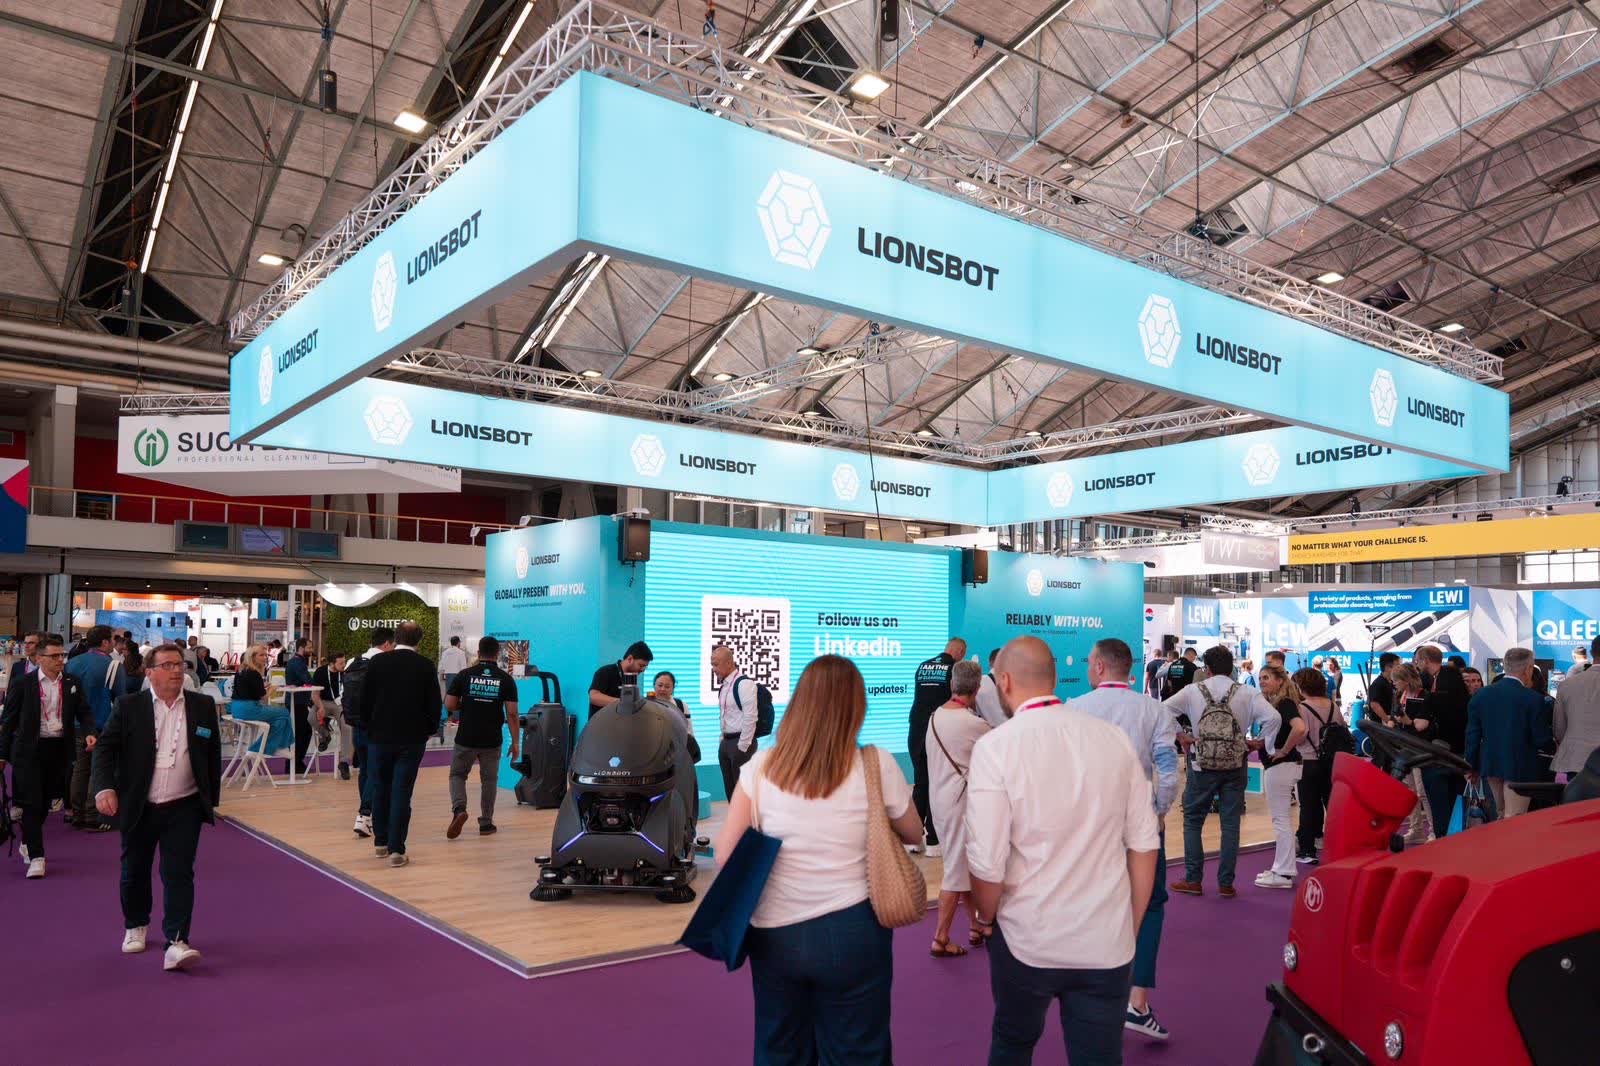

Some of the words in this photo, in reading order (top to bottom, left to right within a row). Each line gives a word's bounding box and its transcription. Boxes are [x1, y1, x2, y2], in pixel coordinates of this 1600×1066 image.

[407, 209, 482, 285] LIONSBOT
[858, 227, 999, 291] LIONSBOT
[278, 328, 319, 374] LIONSBOT
[1196, 333, 1282, 375] LIONSBOT
[1407, 396, 1465, 428] LIONSBOT
[430, 419, 533, 446] LIONSBOT
[177, 455, 256, 464] PROFESSIONAL
[264, 454, 319, 462] CLEANING
[679, 453, 757, 476] LIONSBOT
[870, 480, 932, 498] LIONSBOT
[1084, 472, 1156, 492] LIONSBOT
[1302, 543, 1331, 551] MATTER
[1331, 541, 1352, 549] WHAT
[1353, 539, 1373, 548] YOUR
[1375, 536, 1417, 546] CHALLENGE
[1418, 535, 1428, 543] IS.
[531, 554, 560, 566] LIONSBOT
[495, 588, 522, 600] GLOBALLY
[523, 585, 549, 598] PRESENT
[549, 584, 568, 597] WITH
[1046, 580, 1081, 589] LIONSBOT
[1228, 600, 1249, 610] LEWI
[1373, 594, 1397, 602] ranging
[1429, 589, 1463, 604] LEWI
[817, 612, 861, 626] Follow
[864, 616, 879, 627] us
[882, 617, 898, 628] on
[1006, 613, 1052, 626] RELIABLY
[1054, 615, 1080, 628] WITH
[1081, 616, 1104, 629] YOU.
[1188, 604, 1215, 623] LEWI
[361, 619, 415, 629] SUCITE
[1536, 619, 1600, 641] QLEE
[1263, 623, 1308, 647] LEW
[814, 633, 903, 657] LinkedIn
[470, 684, 500, 693] FUTURE
[868, 684, 907, 696] updates!
